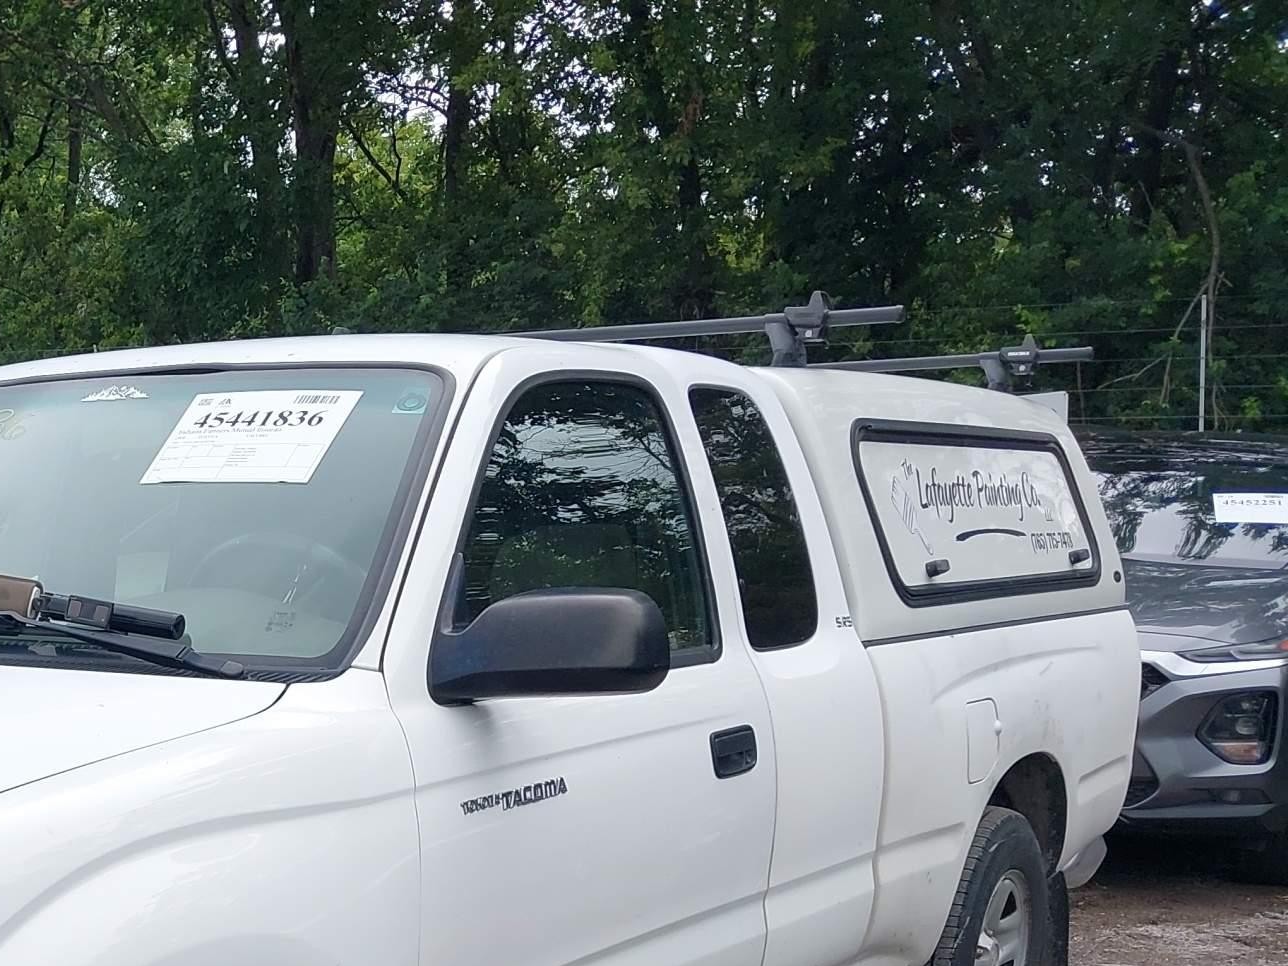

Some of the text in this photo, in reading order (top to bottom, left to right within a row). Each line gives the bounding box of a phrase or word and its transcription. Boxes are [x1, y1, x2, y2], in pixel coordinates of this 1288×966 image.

[193, 410, 328, 428] 45441836
[901, 458, 1041, 523] The Lafayette Painting Co.
[835, 616, 853, 628] SR5
[500, 776, 568, 811] TACOMA
